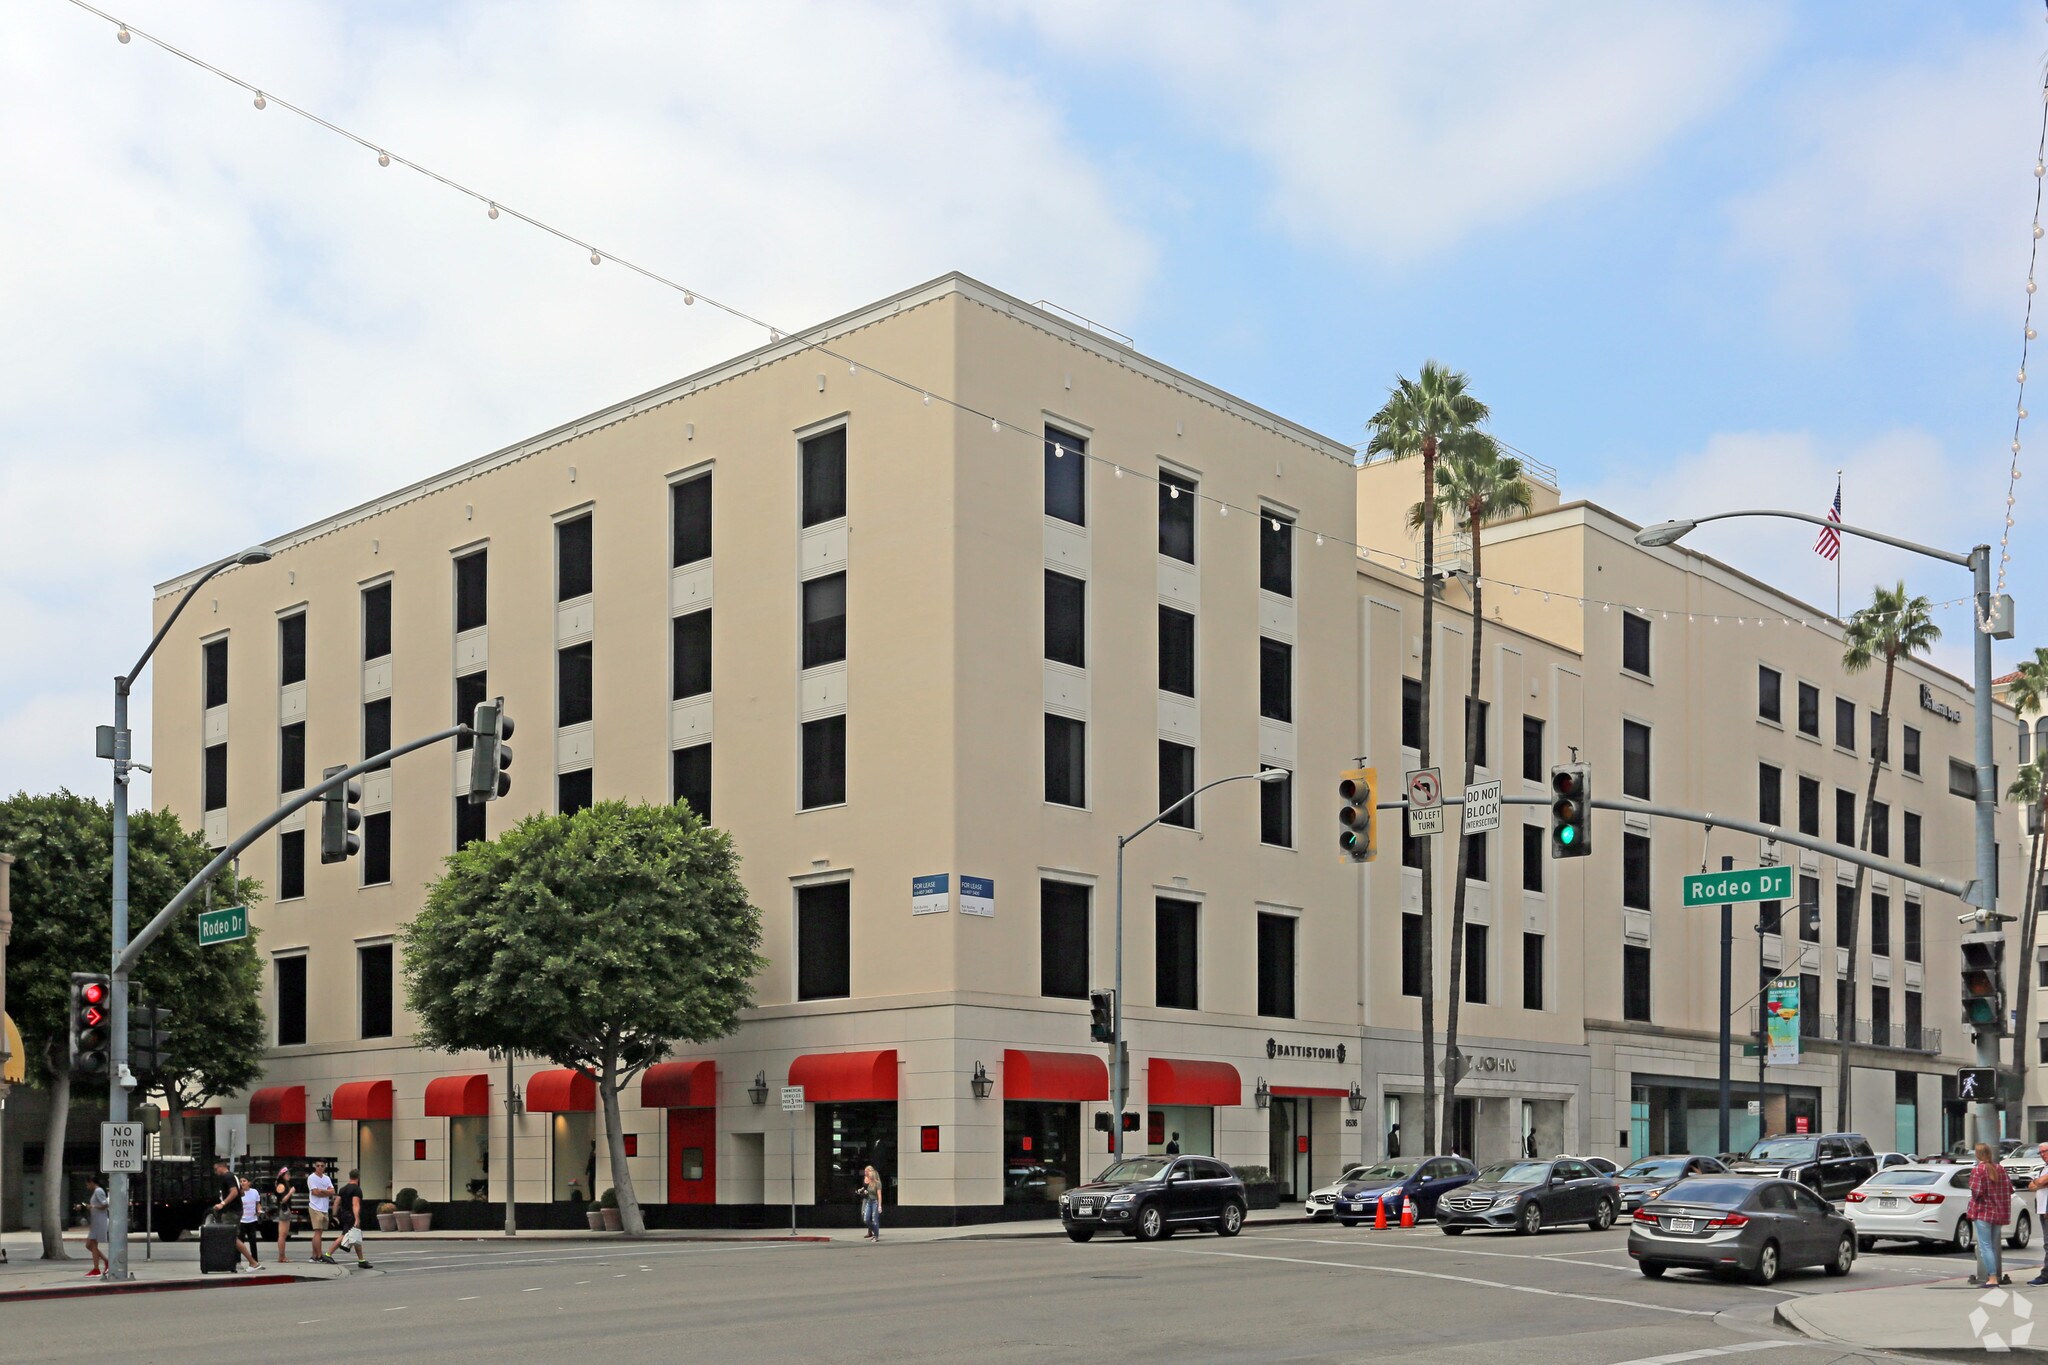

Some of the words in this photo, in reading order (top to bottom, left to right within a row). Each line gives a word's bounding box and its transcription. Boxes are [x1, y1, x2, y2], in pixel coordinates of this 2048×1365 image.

[1467, 791, 1479, 803] DO
[1481, 787, 1498, 800] NOT
[1412, 811, 1423, 820] NO
[1424, 810, 1440, 819] LEFT
[1467, 803, 1498, 818] BLOCK
[1418, 822, 1435, 830] TURN
[1466, 817, 1498, 829] INTERSECTION
[1692, 880, 1751, 898] Rodeo
[1760, 876, 1782, 892] Dr
[203, 920, 229, 936] Rodeo
[232, 916, 242, 931] Dr
[1277, 1044, 1335, 1059] BATTISTONI
[1475, 1056, 1517, 1073] JOHN
[1345, 1119, 1358, 1127] 9536
[113, 1127, 132, 1136] NO
[110, 1139, 135, 1147] TURN
[113, 1160, 131, 1168] RED
